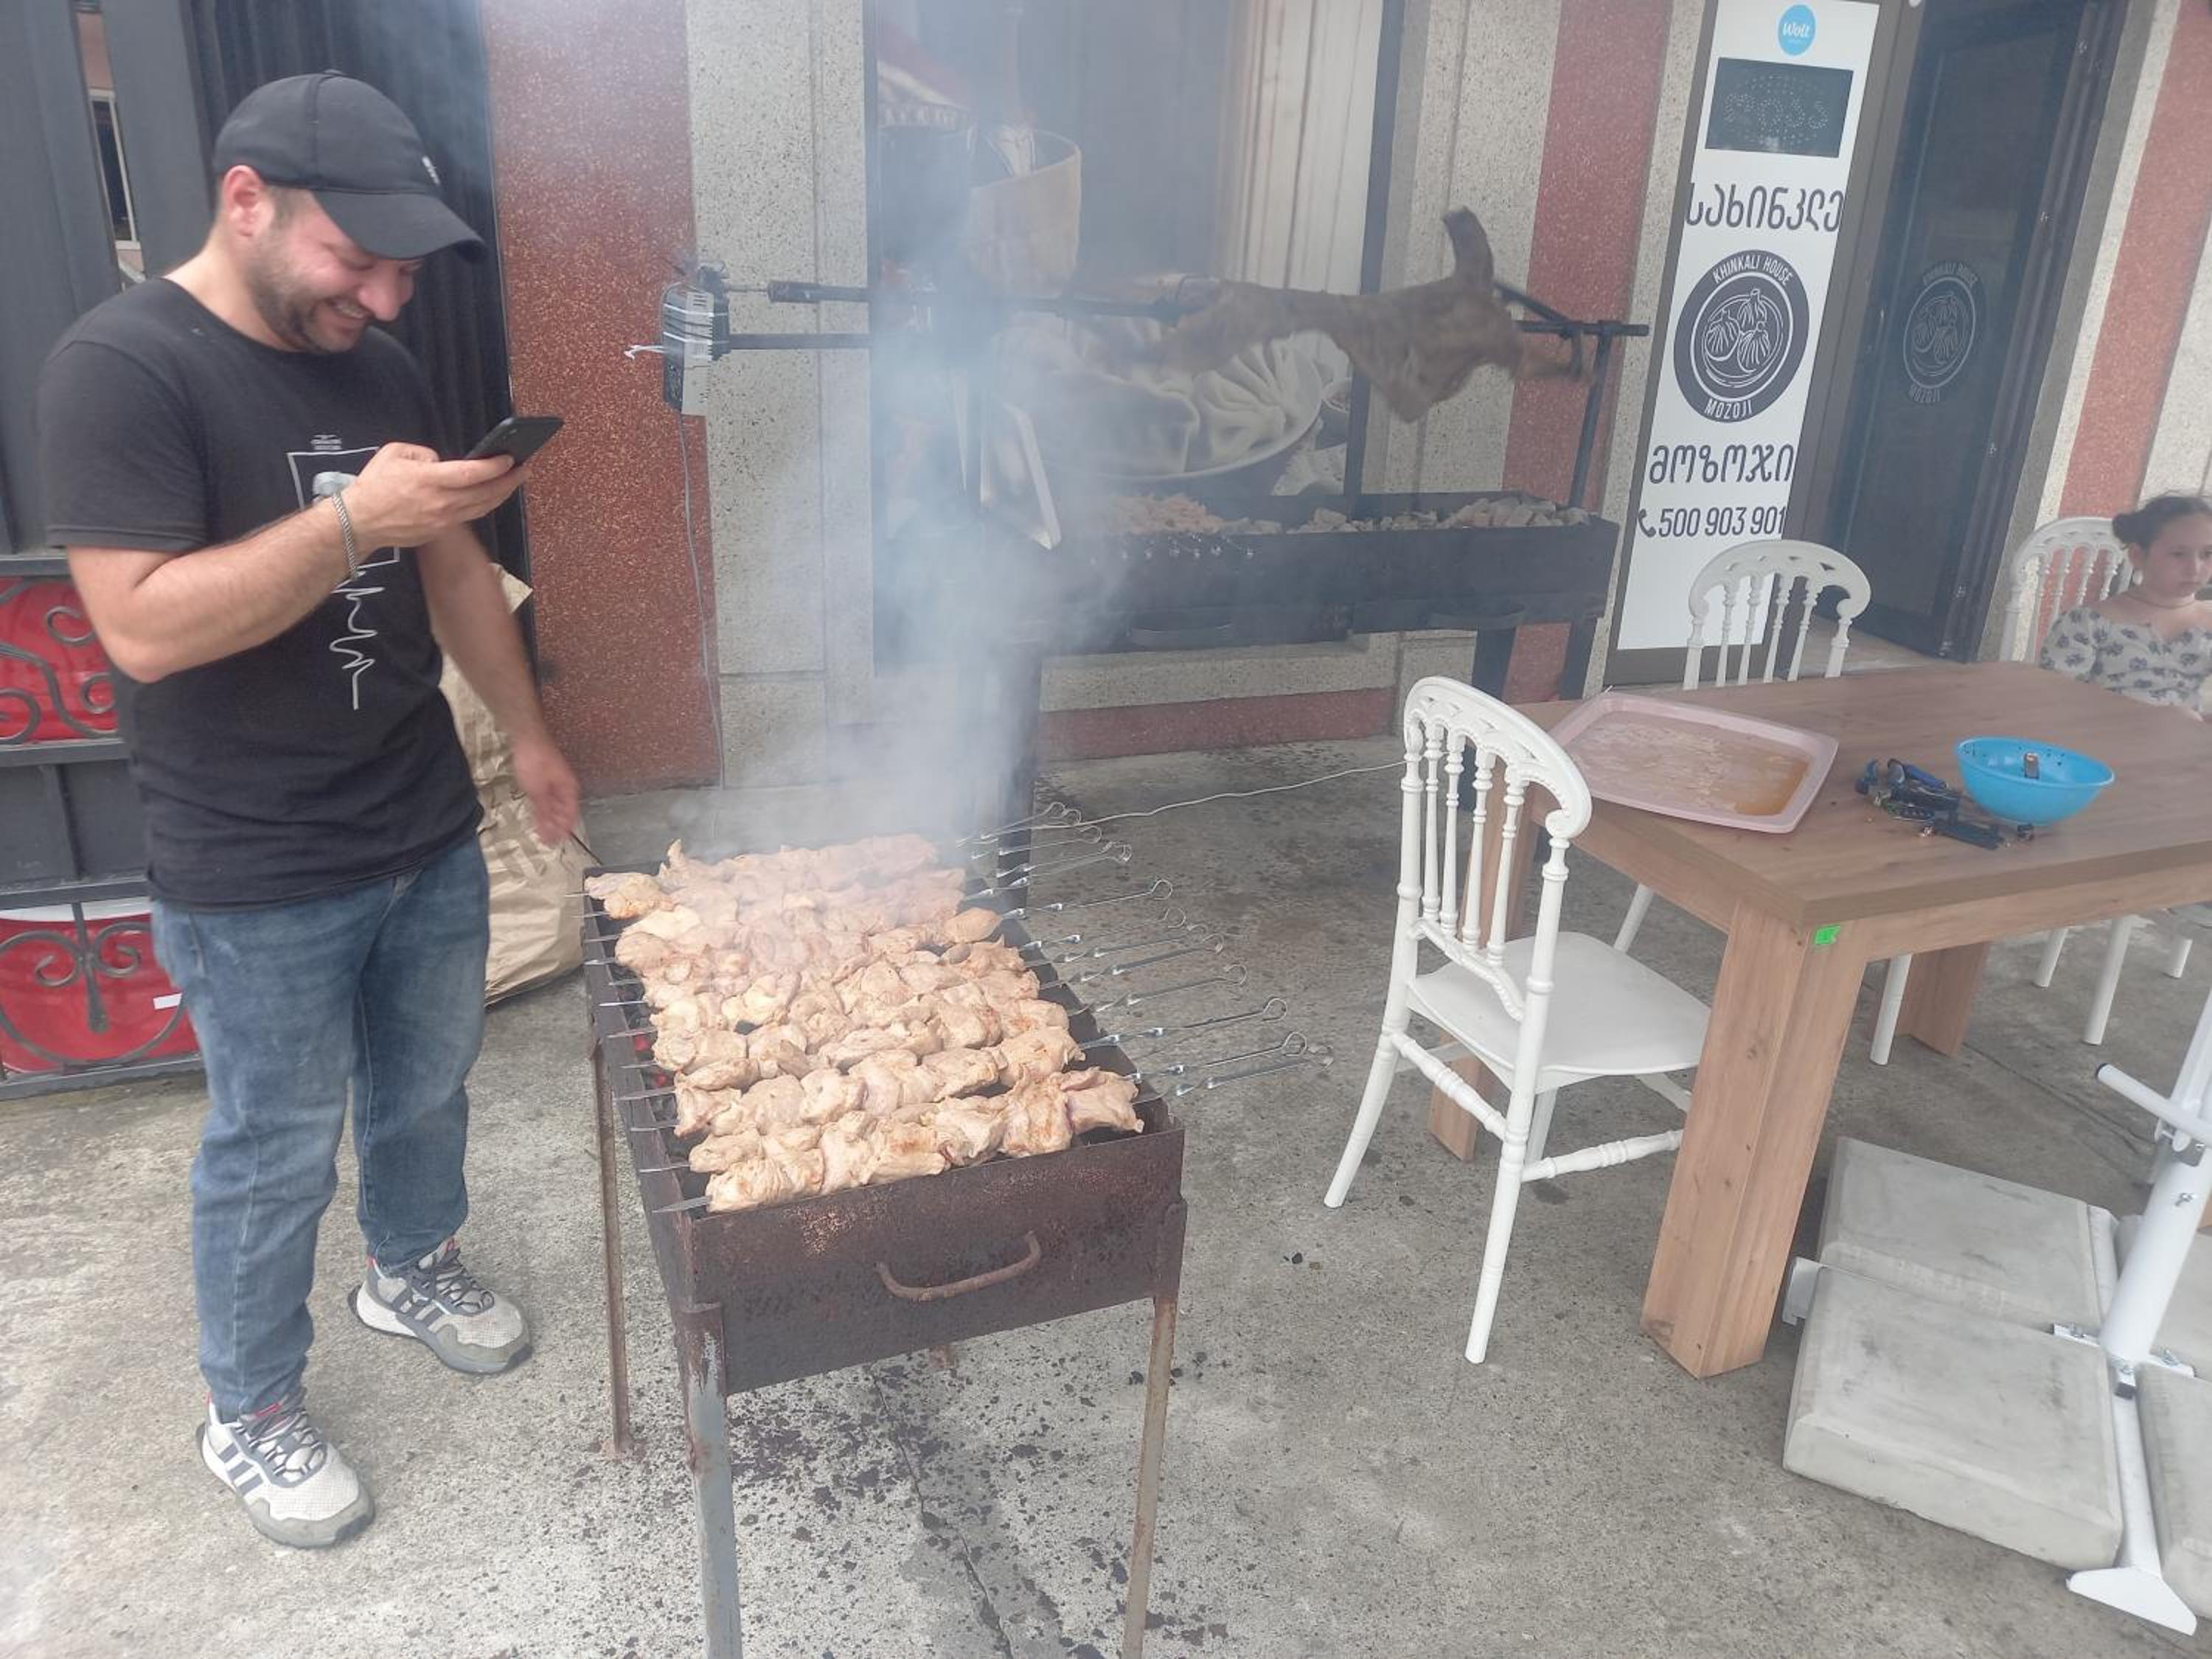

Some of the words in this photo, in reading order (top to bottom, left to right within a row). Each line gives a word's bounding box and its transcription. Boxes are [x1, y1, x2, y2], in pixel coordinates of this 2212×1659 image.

[1782, 23, 1811, 38] Wolt
[1686, 183, 1844, 232] სახინკლე
[1712, 254, 1761, 285] KHINKALI
[1762, 257, 1793, 285] HOUSE
[1704, 398, 1753, 420] MOZOJI
[1649, 444, 1795, 484] მოზოჯი
[1659, 507, 1701, 537] 500
[1705, 507, 1747, 536] 903
[1750, 506, 1787, 535] 901
